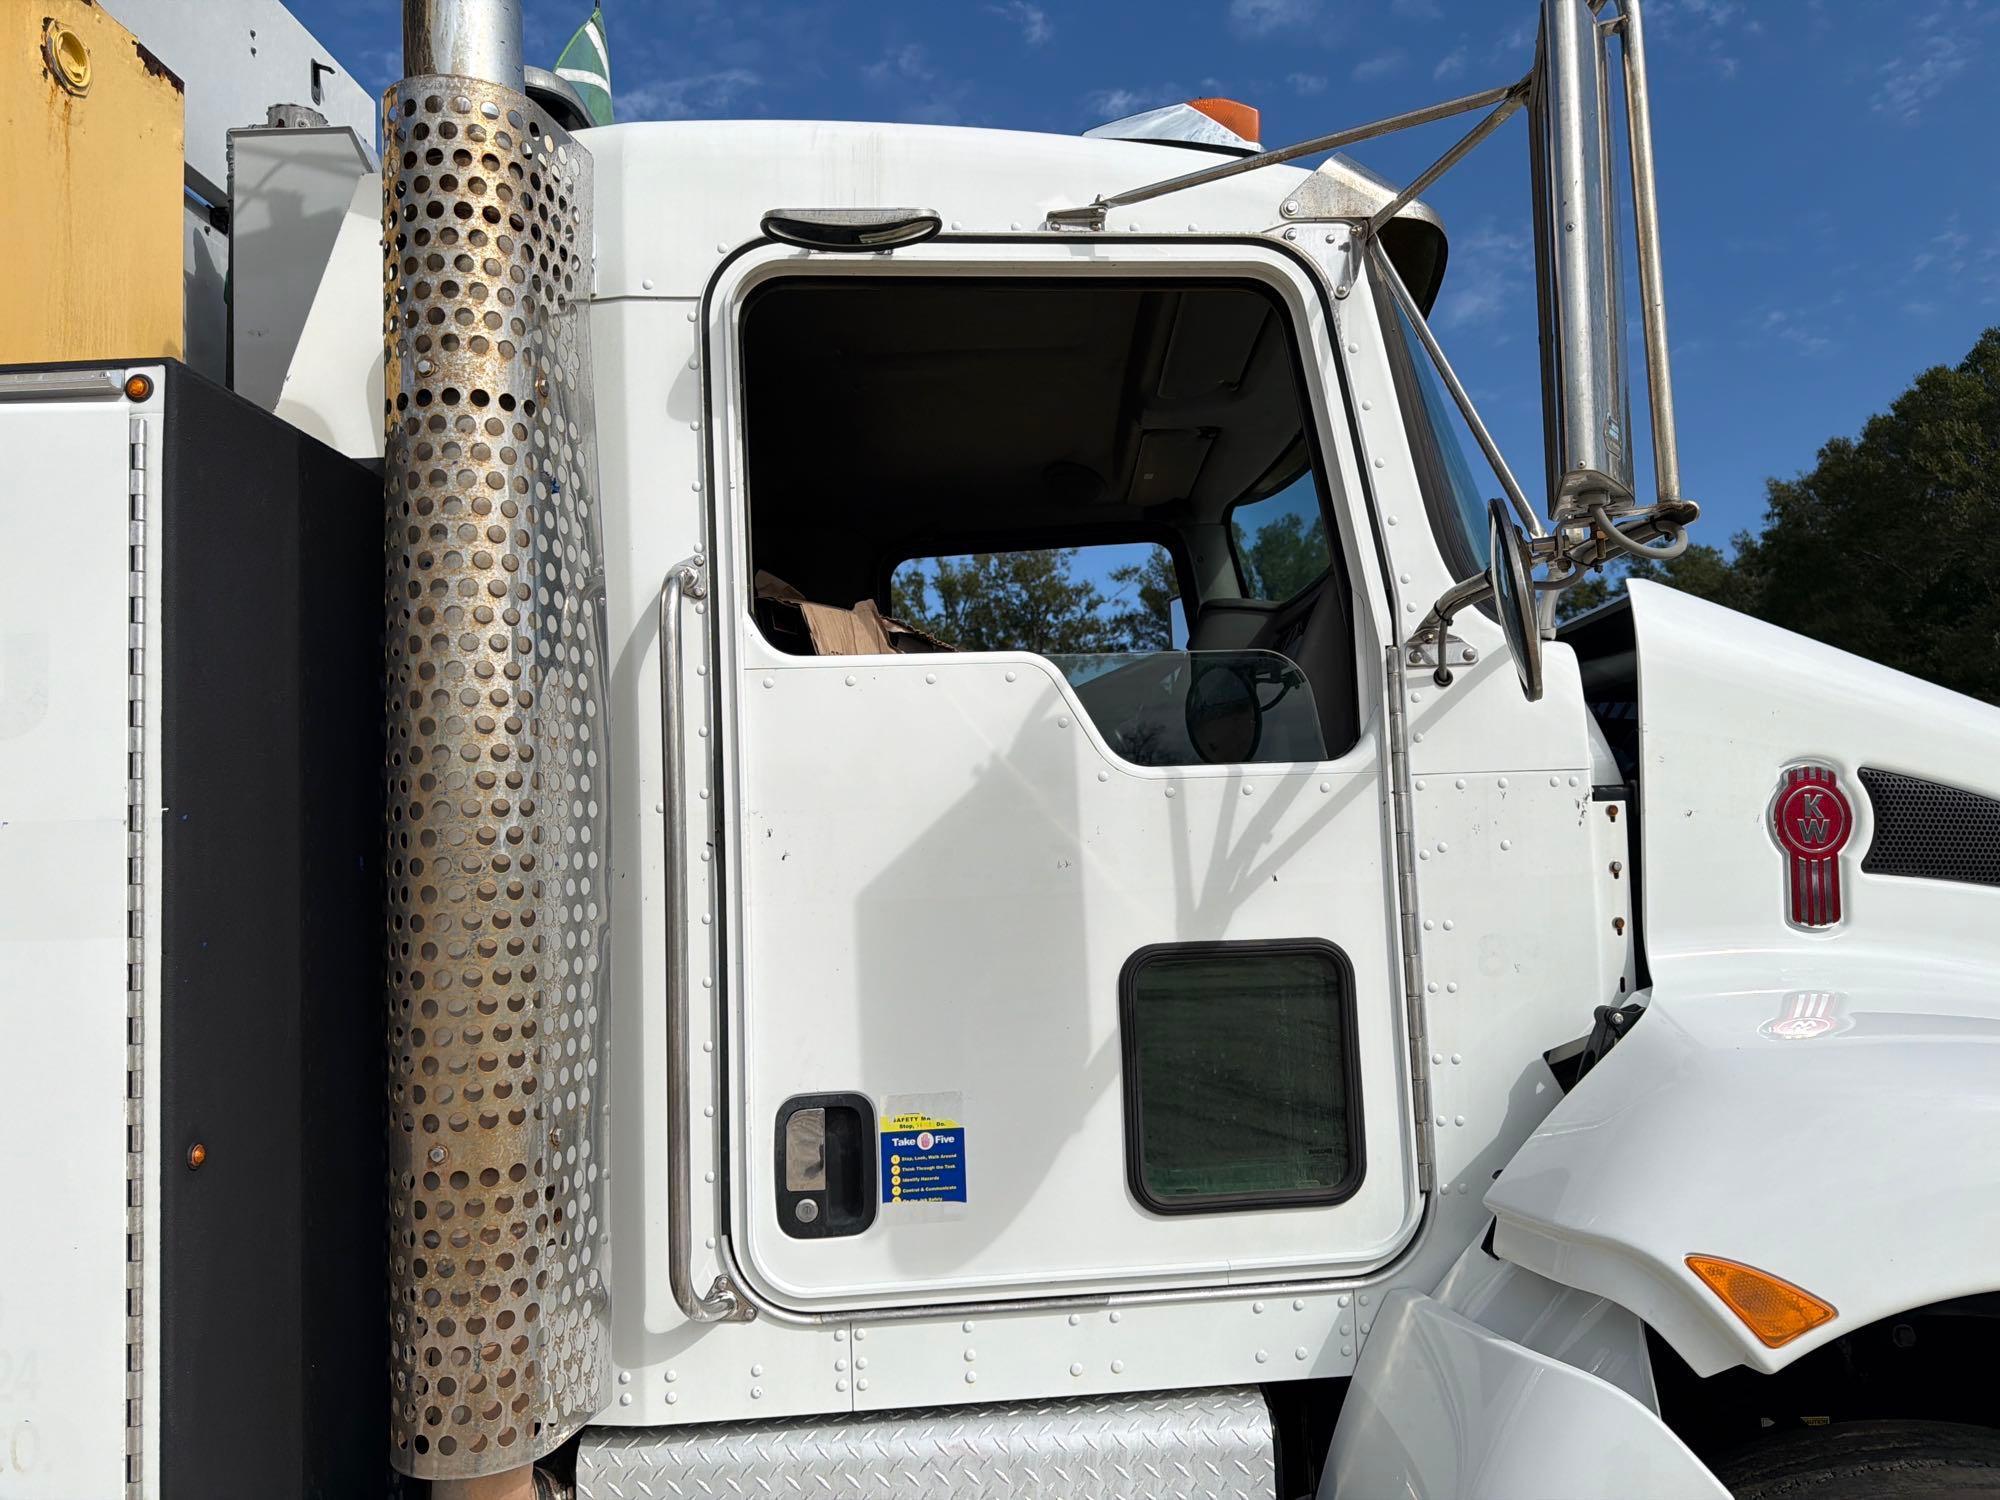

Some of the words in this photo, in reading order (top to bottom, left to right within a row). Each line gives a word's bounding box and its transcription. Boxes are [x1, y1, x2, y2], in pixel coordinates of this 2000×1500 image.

[1804, 794, 1825, 819] K
[1798, 819, 1831, 844] W
[892, 1137, 916, 1147] Take
[935, 1135, 955, 1144] Five
